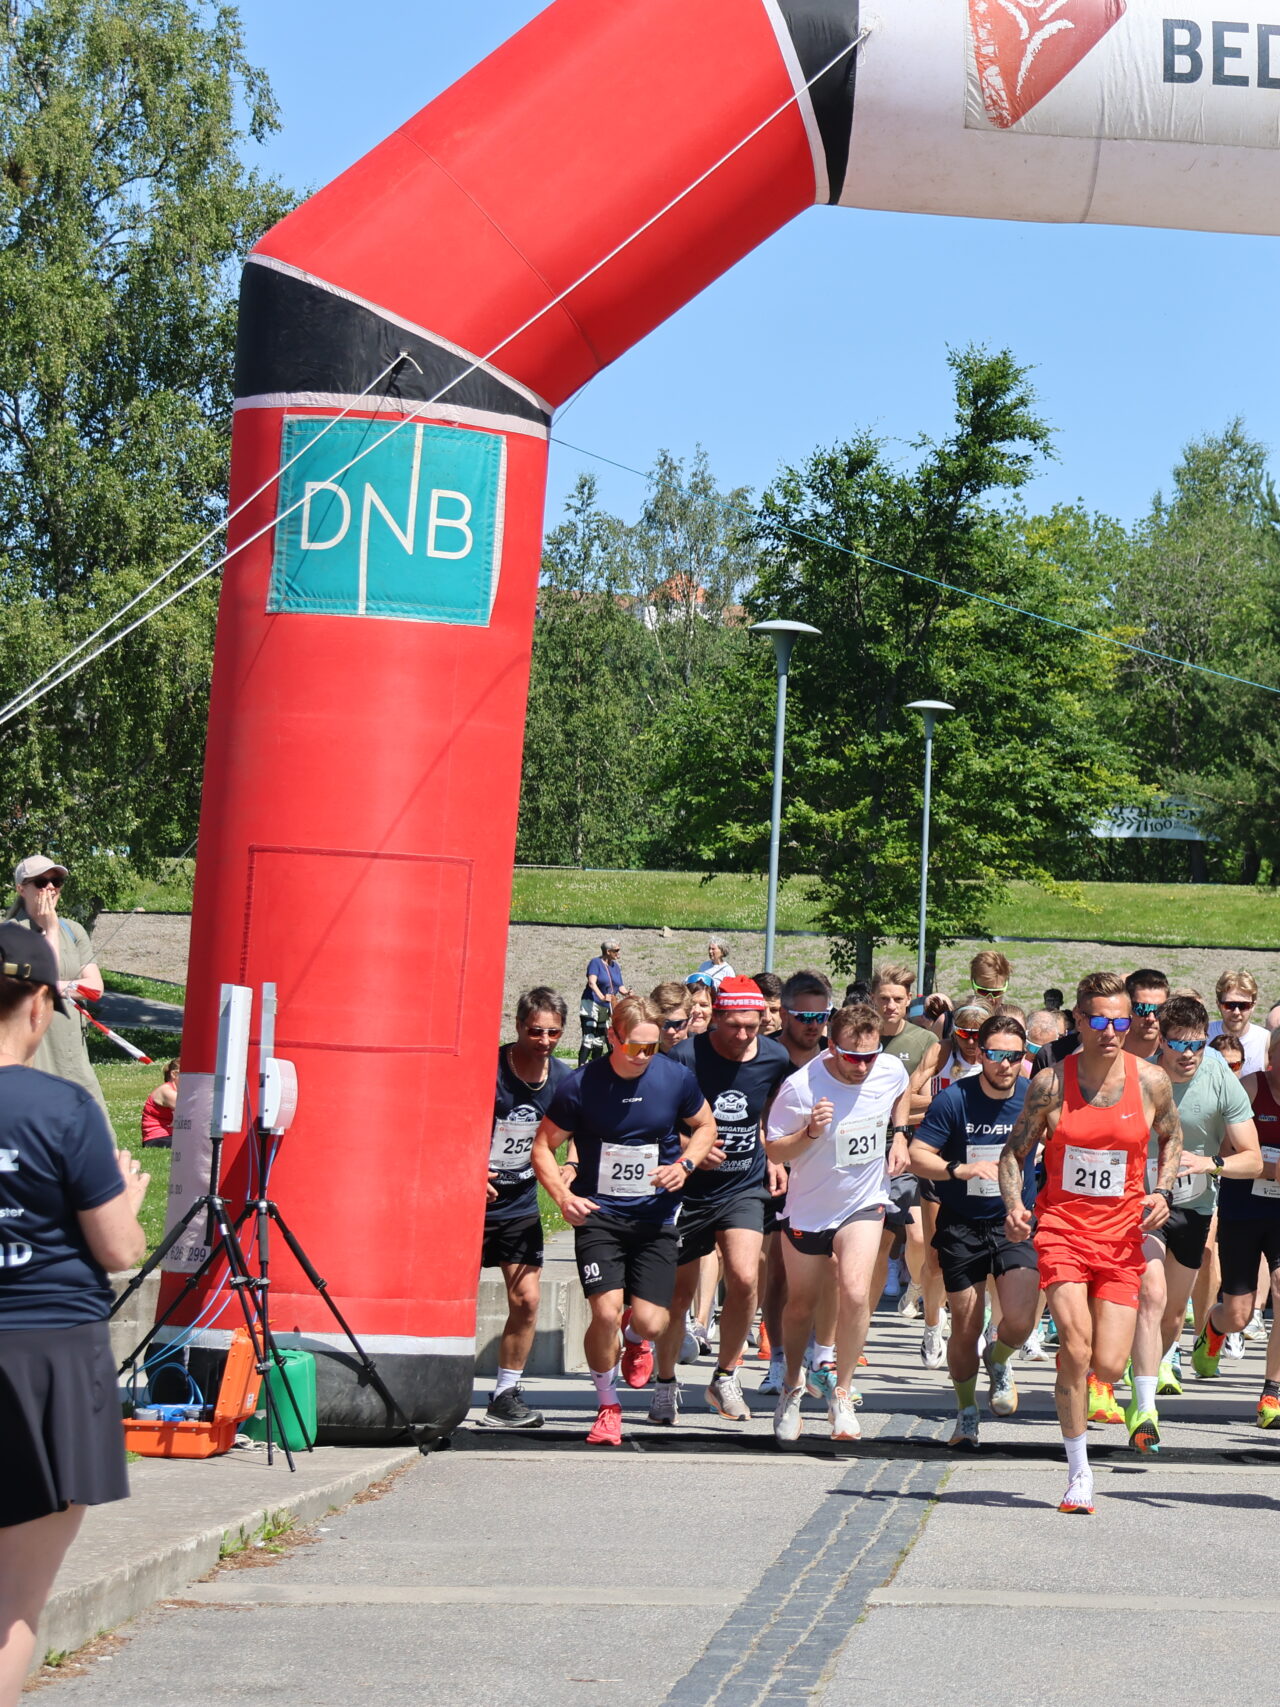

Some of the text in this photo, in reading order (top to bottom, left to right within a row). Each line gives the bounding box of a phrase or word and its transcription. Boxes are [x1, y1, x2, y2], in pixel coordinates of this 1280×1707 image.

[503, 1137, 534, 1155] 252
[848, 1133, 876, 1156] 231
[611, 1163, 645, 1181] 259
[1074, 1168, 1111, 1189] 218
[187, 1247, 207, 1262] 299
[584, 1262, 600, 1279] 90
